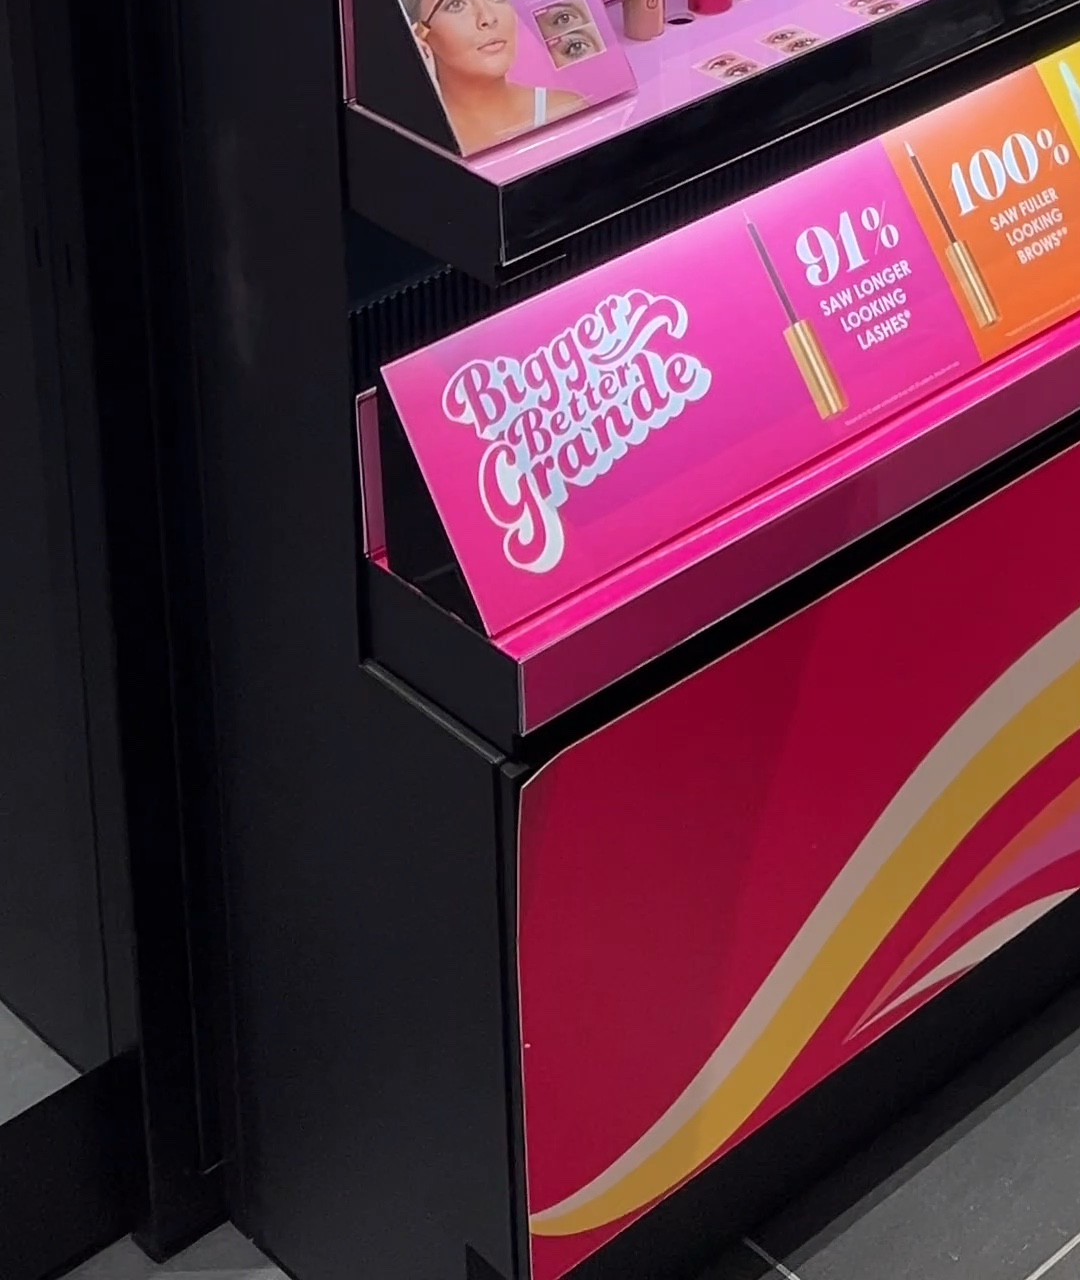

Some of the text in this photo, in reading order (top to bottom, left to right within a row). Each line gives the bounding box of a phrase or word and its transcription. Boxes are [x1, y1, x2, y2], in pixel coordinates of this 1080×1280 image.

[949, 124, 1071, 217] 100%
[990, 187, 1059, 231] SAW FULLER
[795, 201, 900, 287] 91%
[1005, 208, 1064, 247] LOOKING
[819, 260, 913, 317] SAW LONGER
[840, 288, 907, 333] LOOKING
[443, 290, 686, 437] Bigger
[505, 361, 643, 461] Better
[480, 351, 710, 571] Grande
